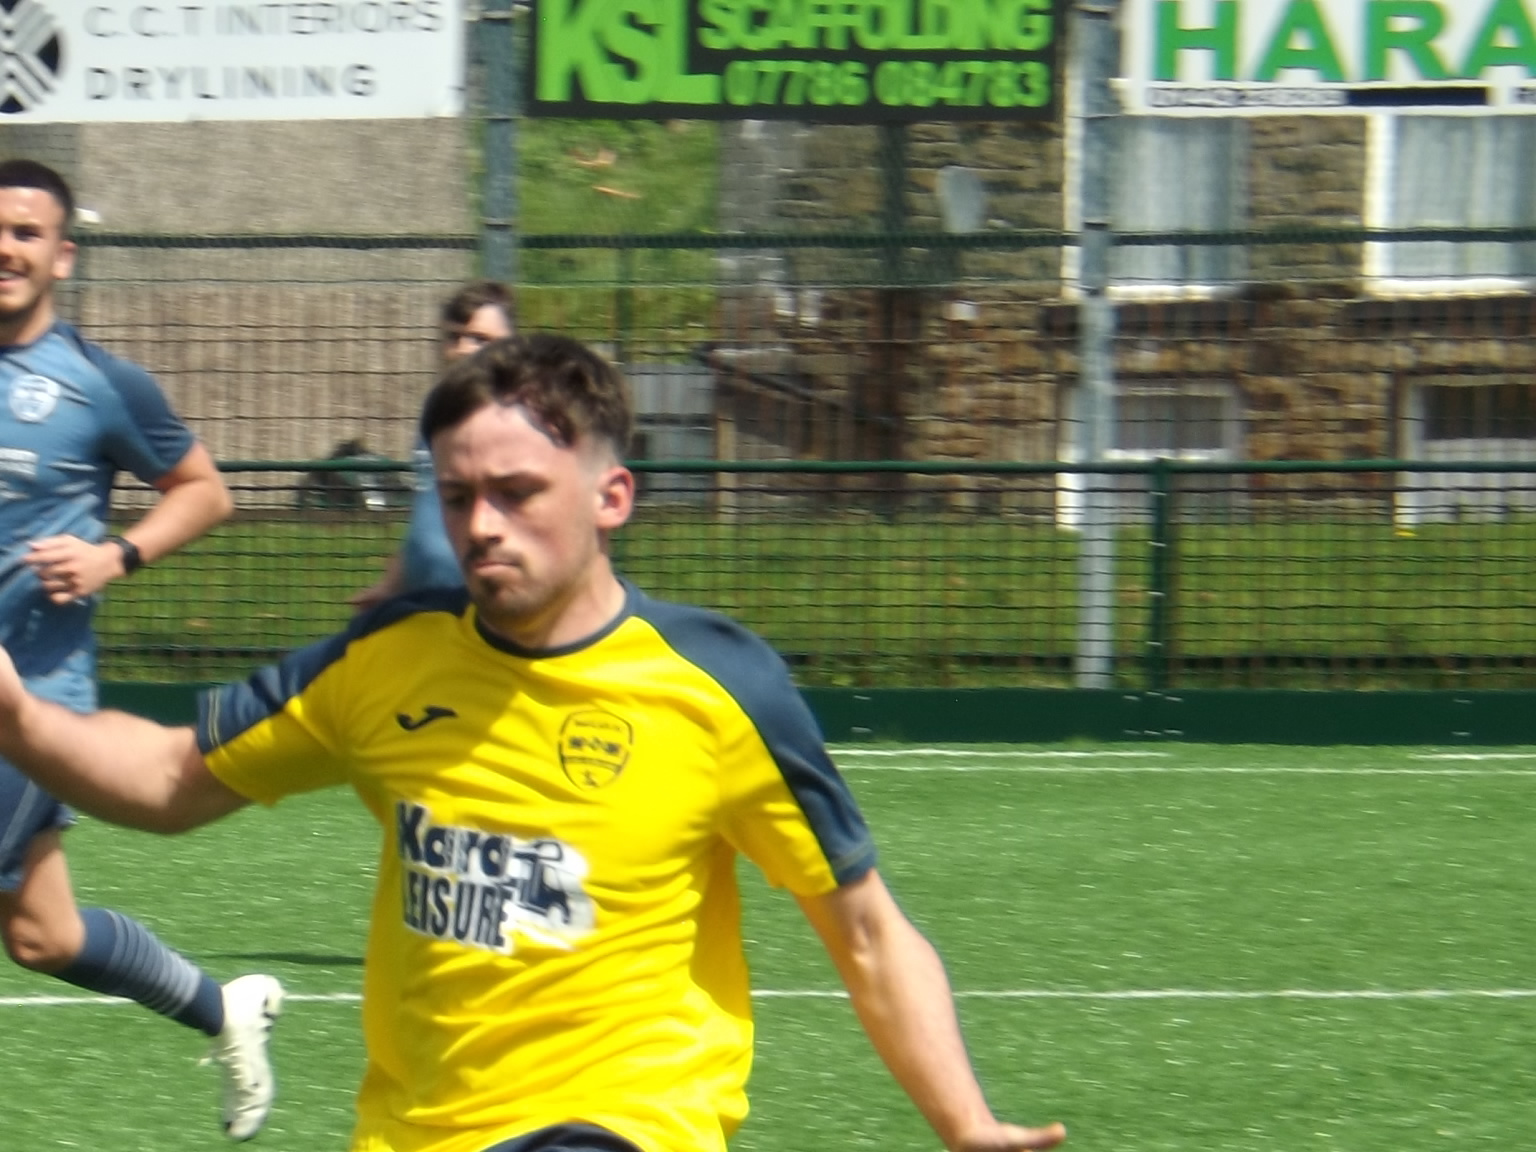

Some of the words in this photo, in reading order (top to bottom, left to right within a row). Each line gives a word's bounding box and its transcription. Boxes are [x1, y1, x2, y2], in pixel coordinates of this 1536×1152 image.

[214, 0, 448, 37] INTERIORS
[696, 0, 1052, 50] SCAFFOLDING
[1151, 0, 1536, 82] HARA
[83, 63, 378, 101] DRYLINING
[534, 0, 721, 104] KSL
[397, 801, 510, 878] Kara
